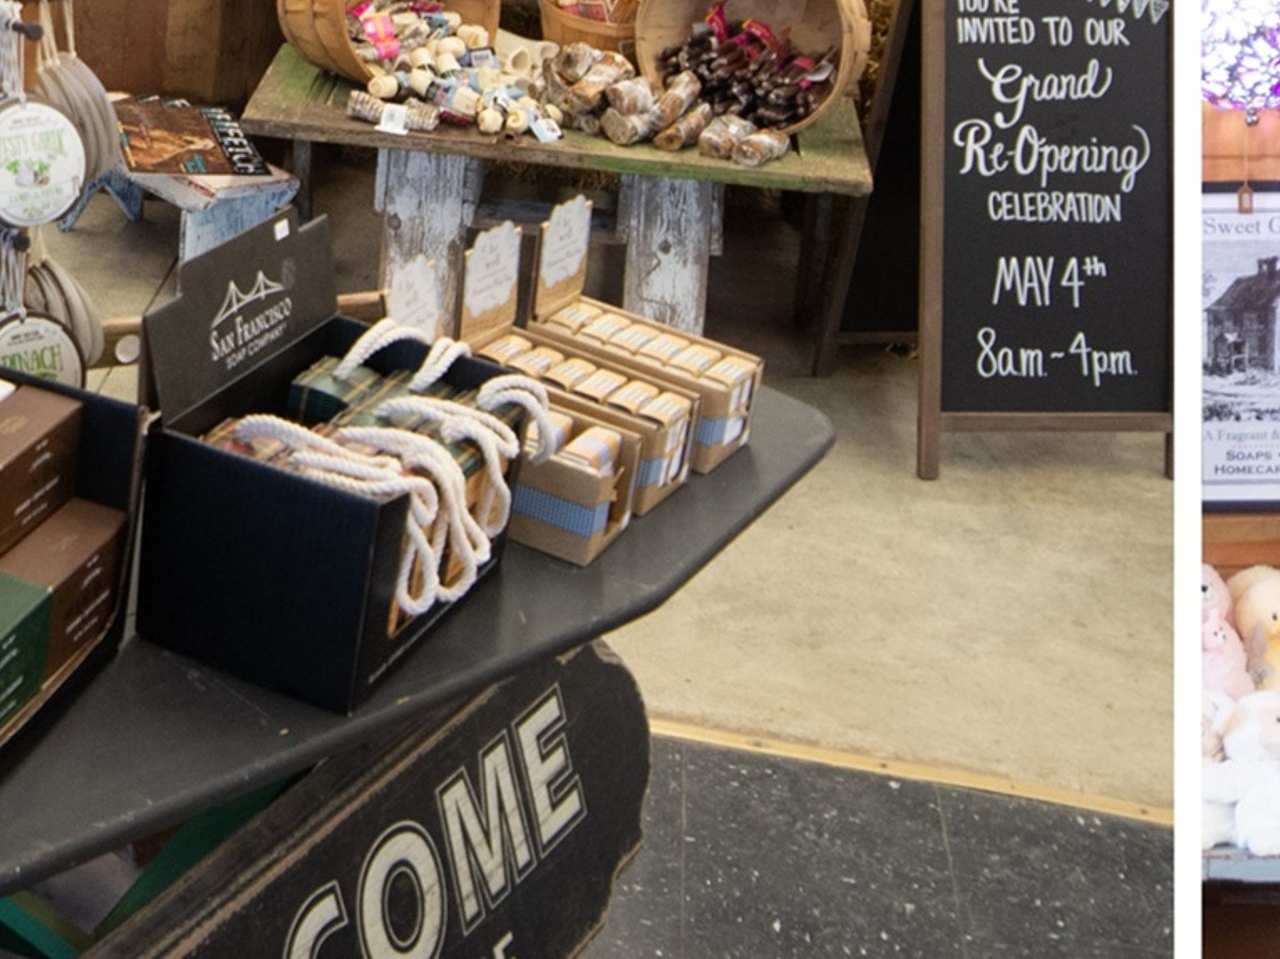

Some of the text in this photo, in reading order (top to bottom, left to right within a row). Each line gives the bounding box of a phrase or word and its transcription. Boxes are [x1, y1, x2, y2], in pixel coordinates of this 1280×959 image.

[956, 16, 1131, 47] INVITED TO OUR
[977, 57, 1113, 129] Grand
[952, 117, 1151, 193] Re-Opening
[987, 191, 1122, 223] CELEBRATION
[1203, 216, 1262, 236] Sweet
[992, 255, 1108, 309] MAY 4th
[210, 296, 293, 361] SAN FRANCISCO
[1216, 428, 1269, 445] Fragrant
[1271, 429, 1280, 441] &
[1225, 449, 1273, 461] SOAPS
